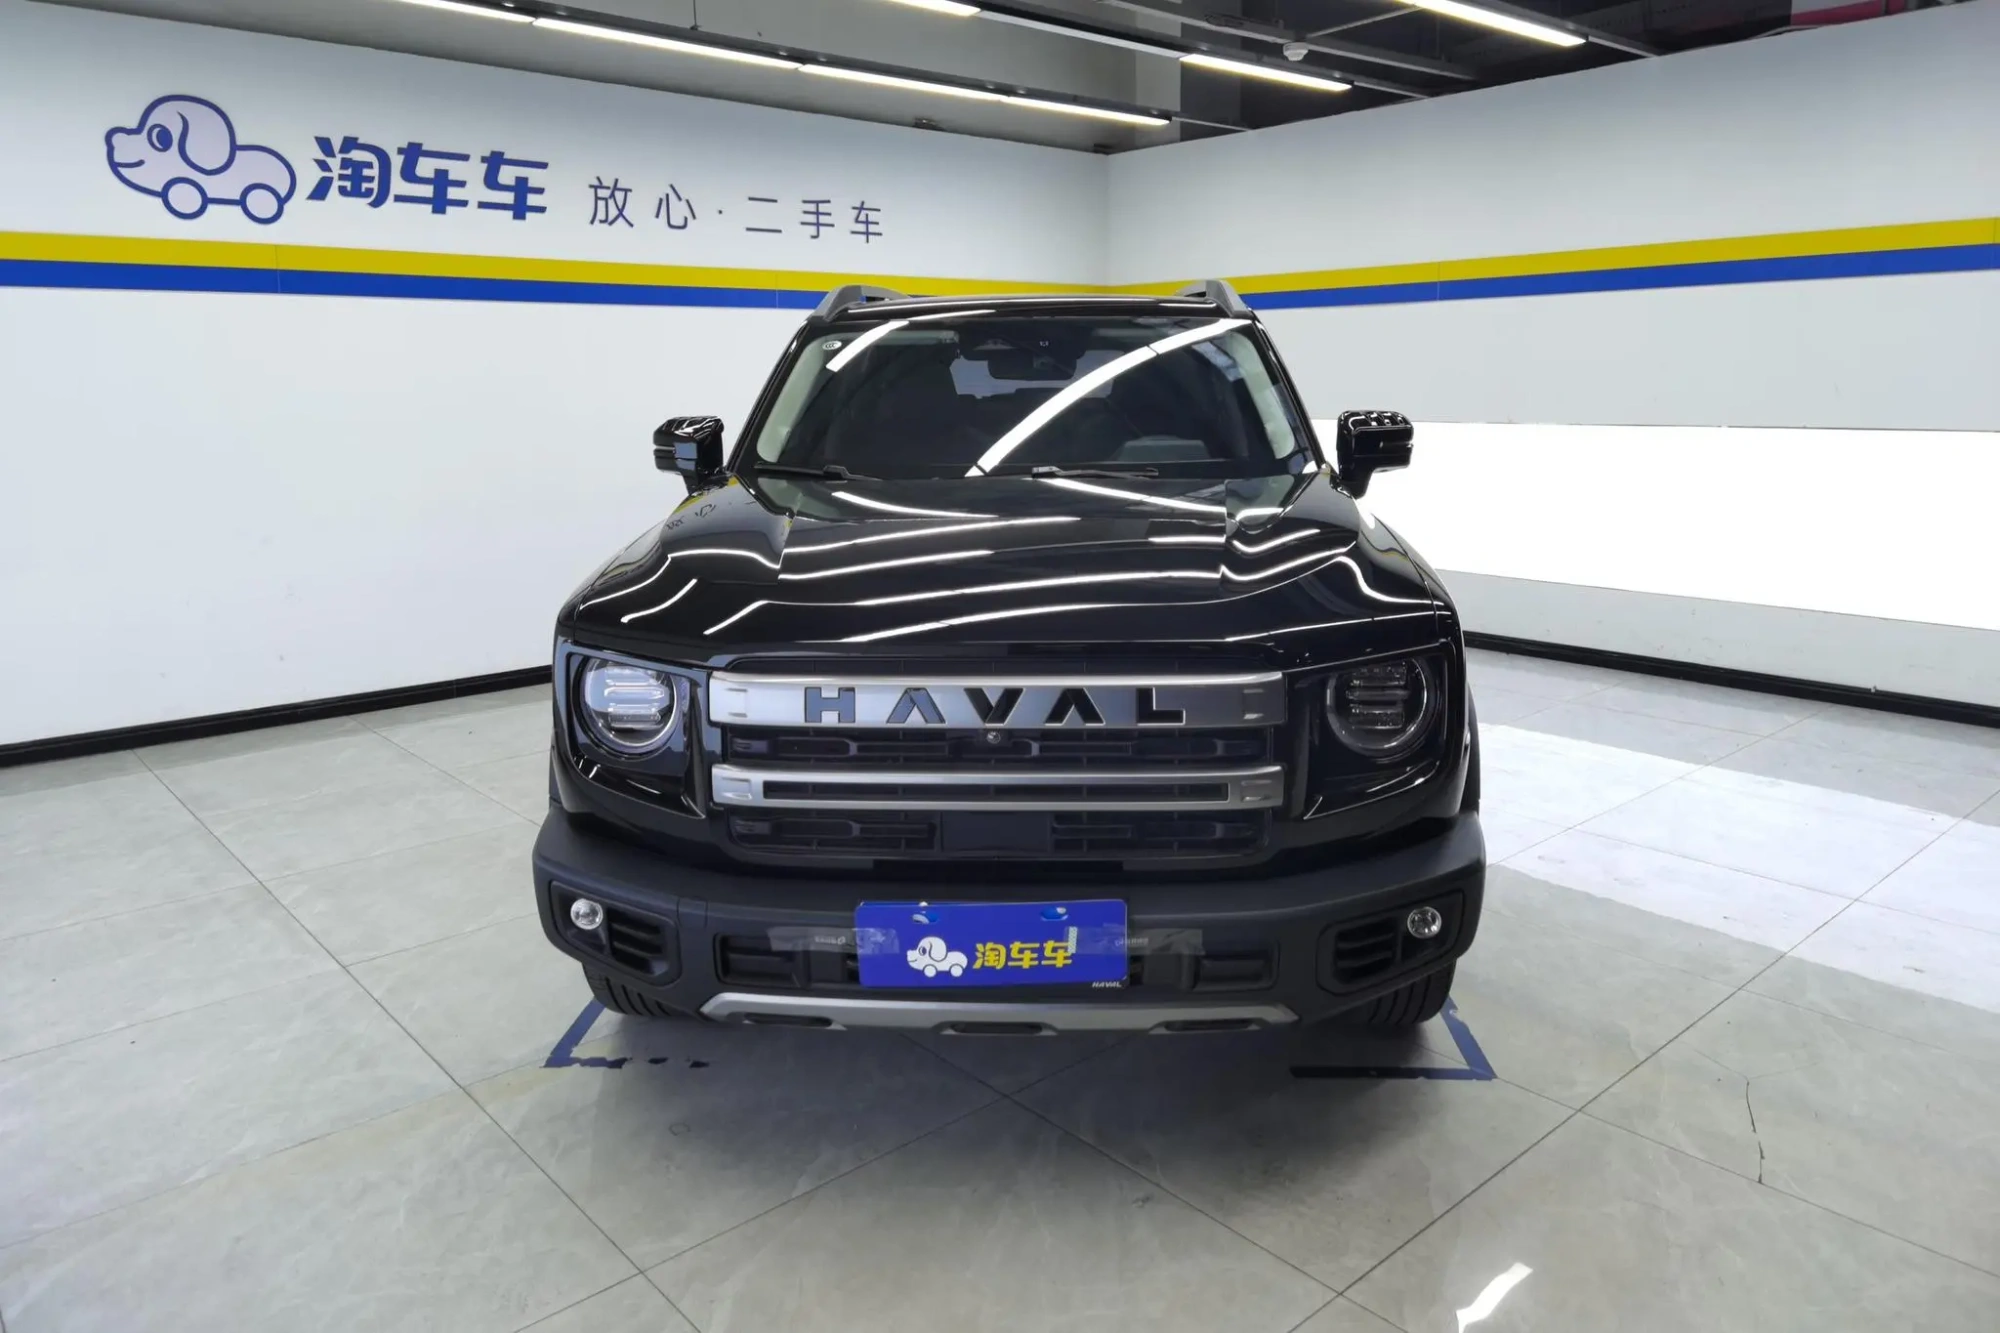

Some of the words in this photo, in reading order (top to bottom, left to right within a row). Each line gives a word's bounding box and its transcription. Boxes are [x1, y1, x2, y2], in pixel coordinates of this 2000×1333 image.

[306, 135, 549, 220] 淘车车
[803, 686, 1186, 725] HAVAL
[972, 940, 1073, 969] 淘车车
